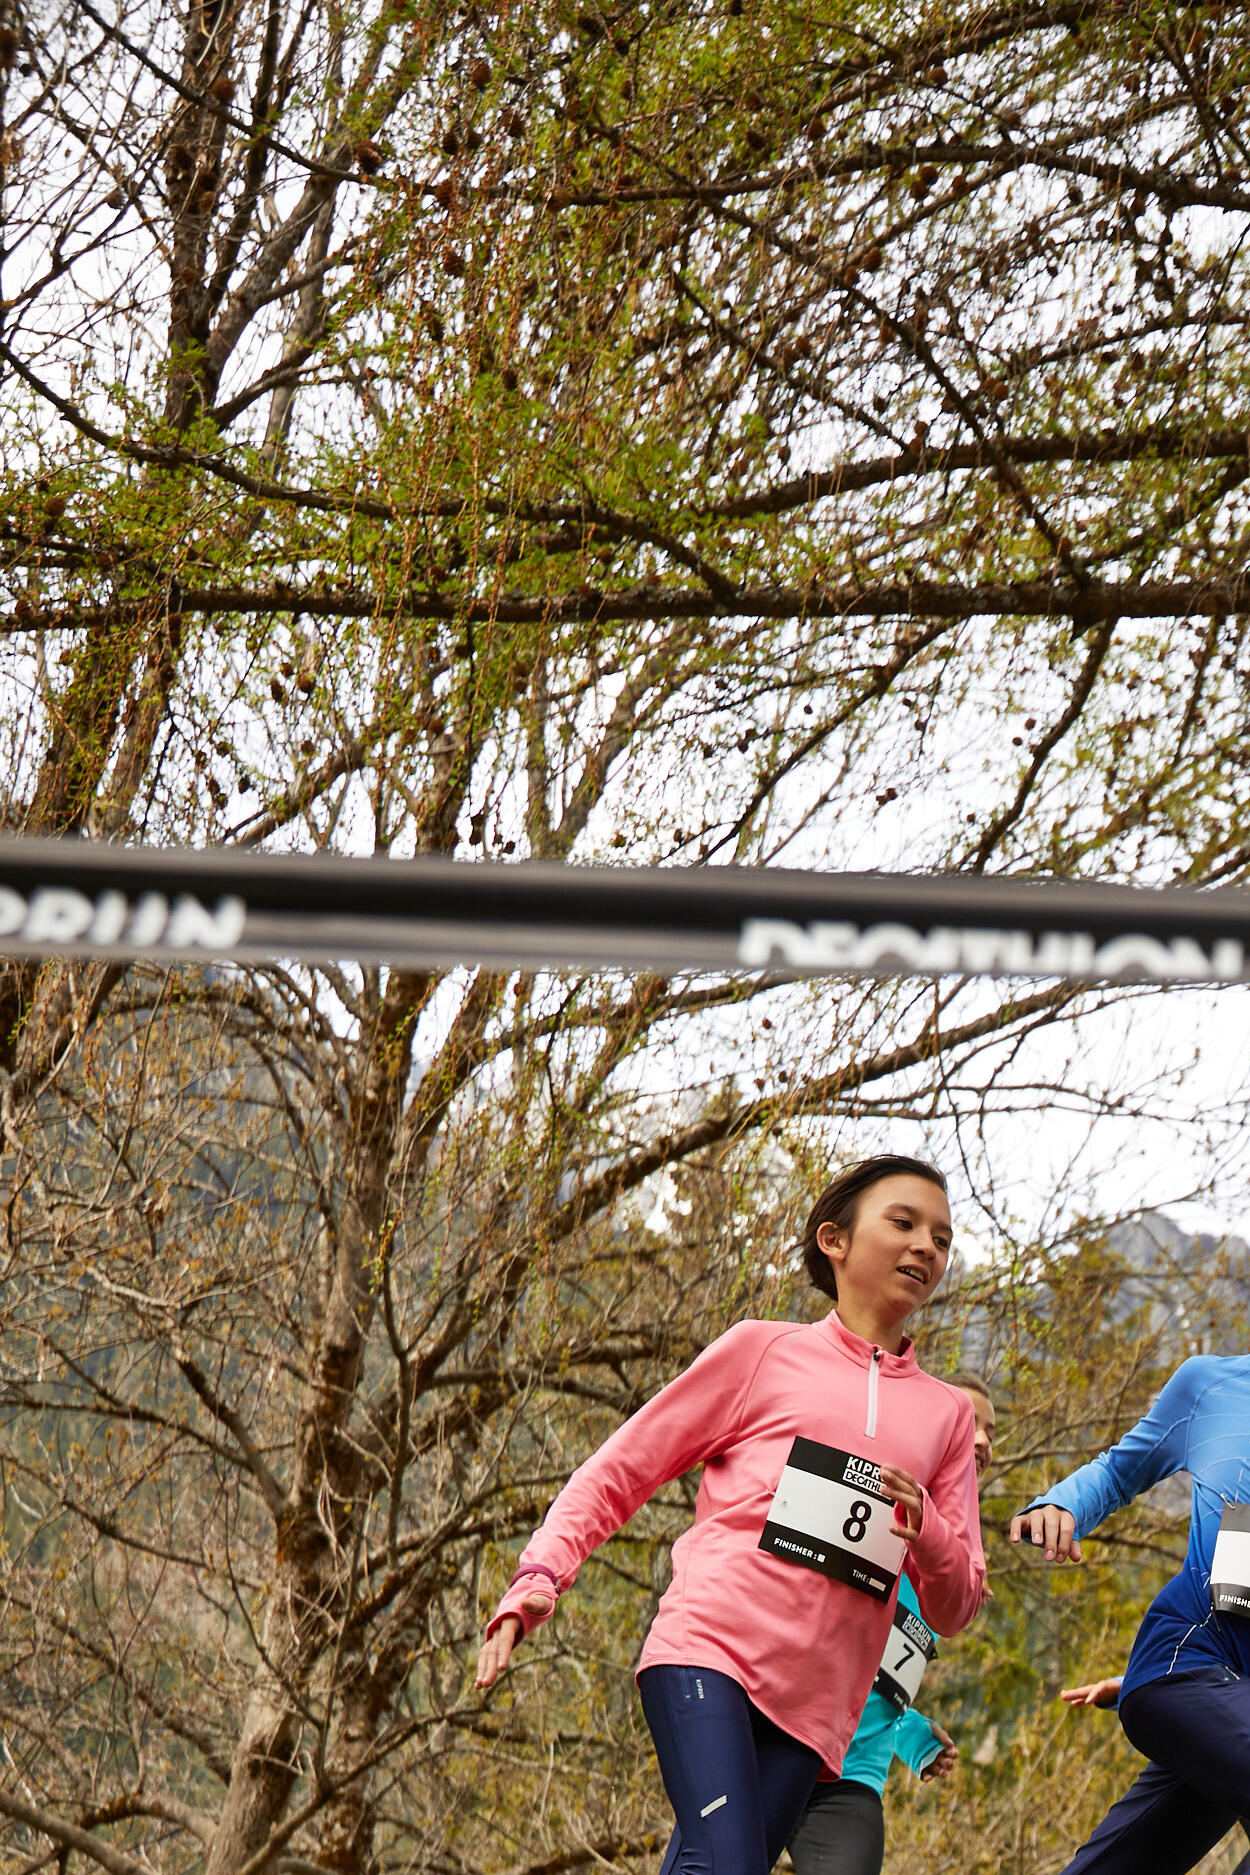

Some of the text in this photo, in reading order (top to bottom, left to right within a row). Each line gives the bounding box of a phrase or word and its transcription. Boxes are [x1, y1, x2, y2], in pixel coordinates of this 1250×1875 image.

[845, 1470, 882, 1493] DECATHL
[847, 1456, 885, 1481] KIPR
[842, 1500, 872, 1543] 8
[905, 1612, 933, 1643] KIPRUN
[893, 1642, 915, 1672] 7
